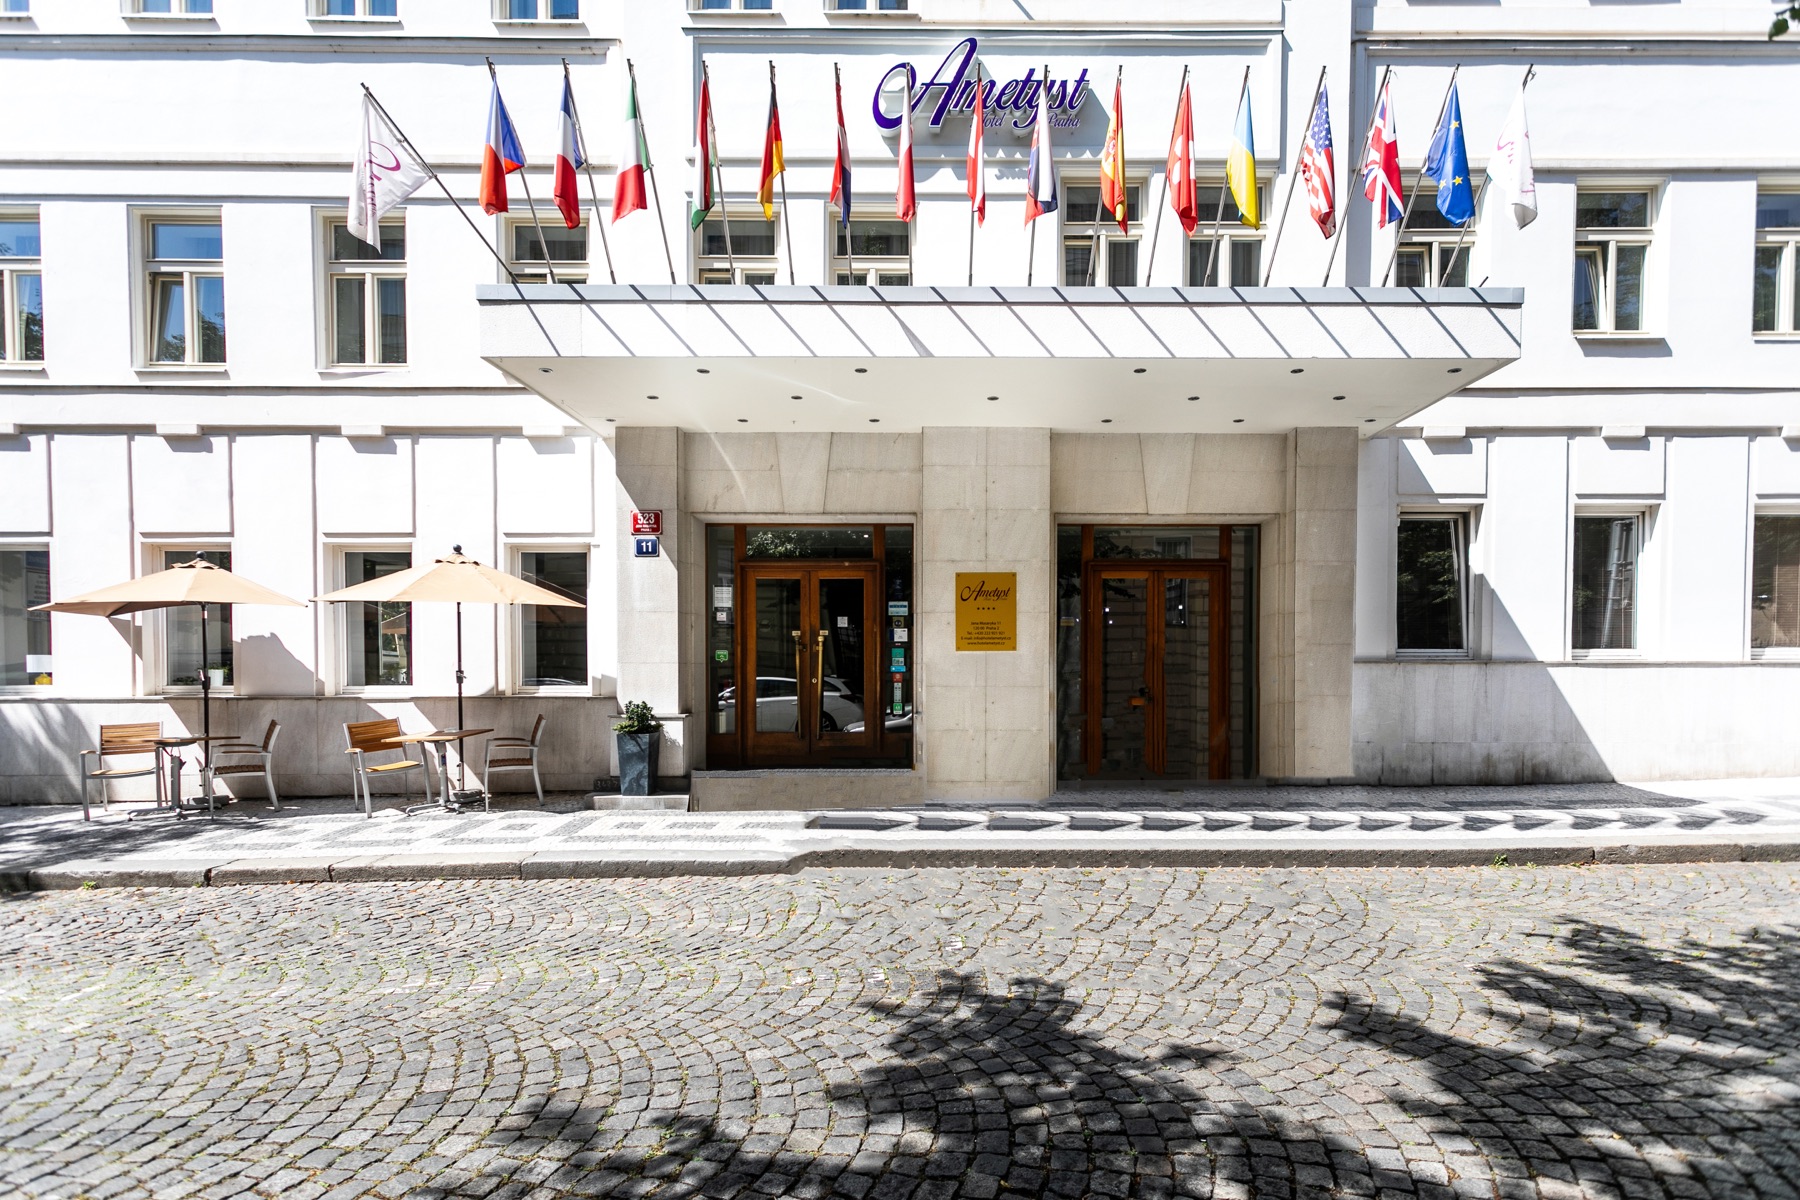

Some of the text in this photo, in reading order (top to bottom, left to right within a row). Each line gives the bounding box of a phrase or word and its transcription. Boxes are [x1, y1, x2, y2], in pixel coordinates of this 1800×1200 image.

[872, 37, 1090, 129] Ametyst
[637, 513, 655, 524] 523
[641, 541, 652, 552] 11
[960, 580, 1011, 602] Ametyst
